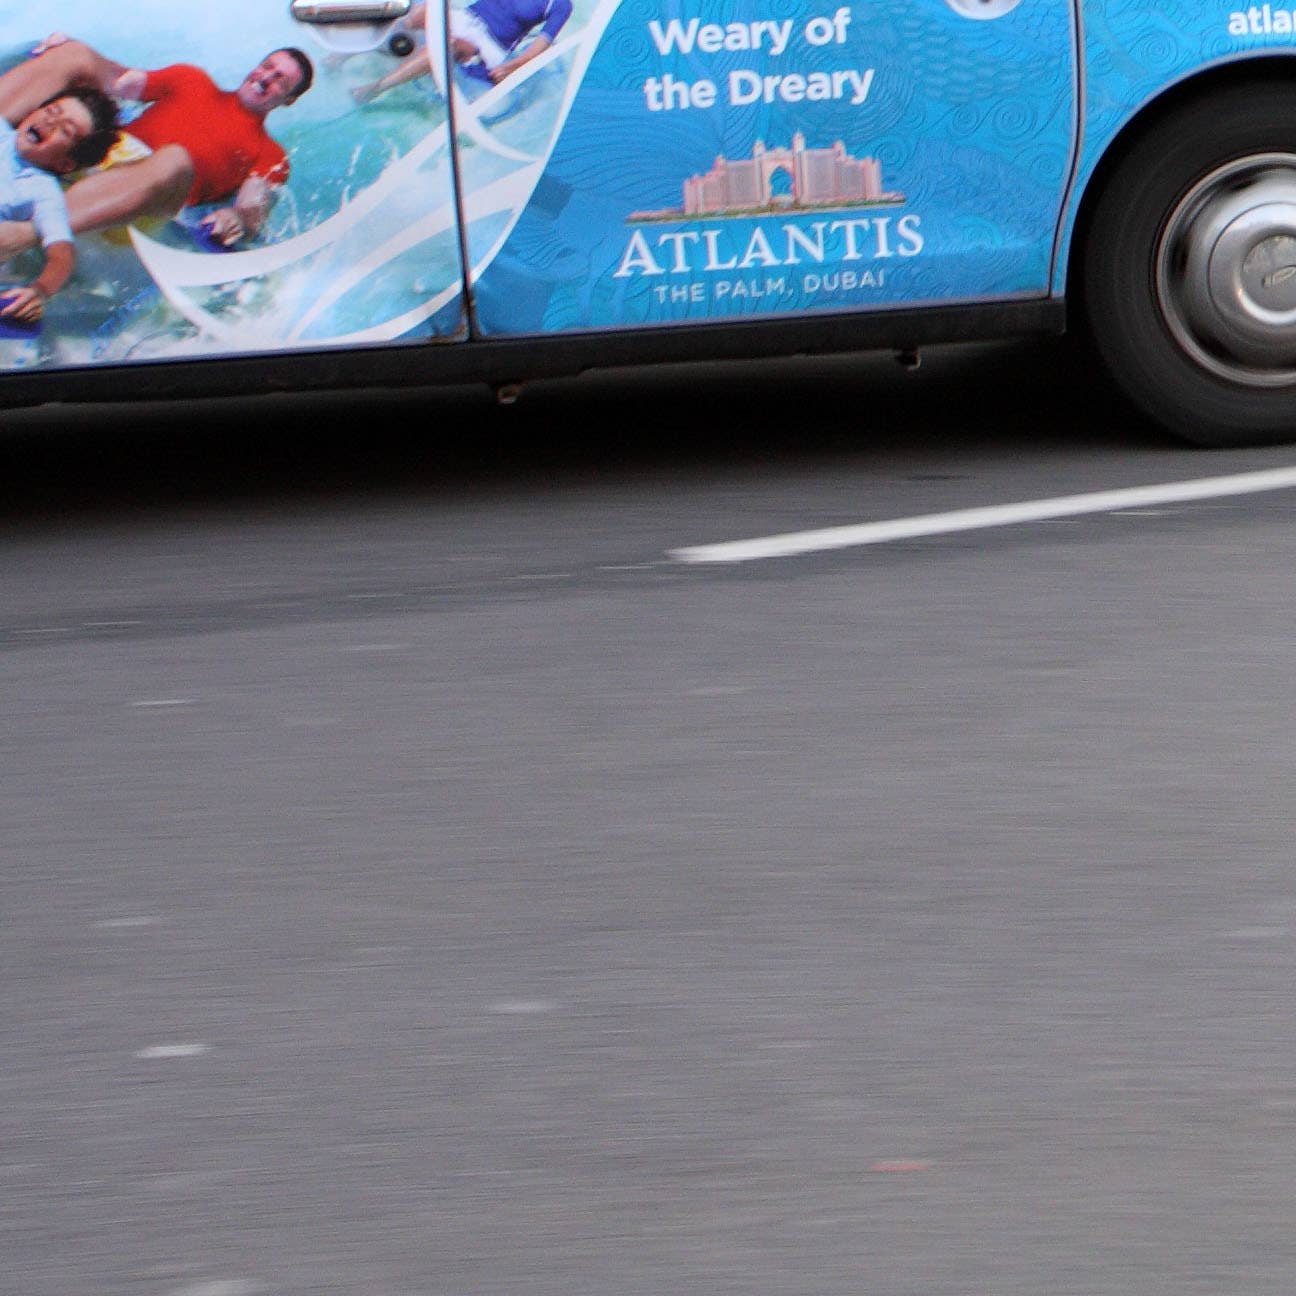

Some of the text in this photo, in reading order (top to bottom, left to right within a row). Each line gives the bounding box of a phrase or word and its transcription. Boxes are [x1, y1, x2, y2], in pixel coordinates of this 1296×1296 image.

[648, 7, 851, 56] Weary of
[643, 68, 875, 112] the Dreary
[612, 214, 925, 278] ATLANTIS
[653, 270, 886, 304] THE PALM, DUBAI
